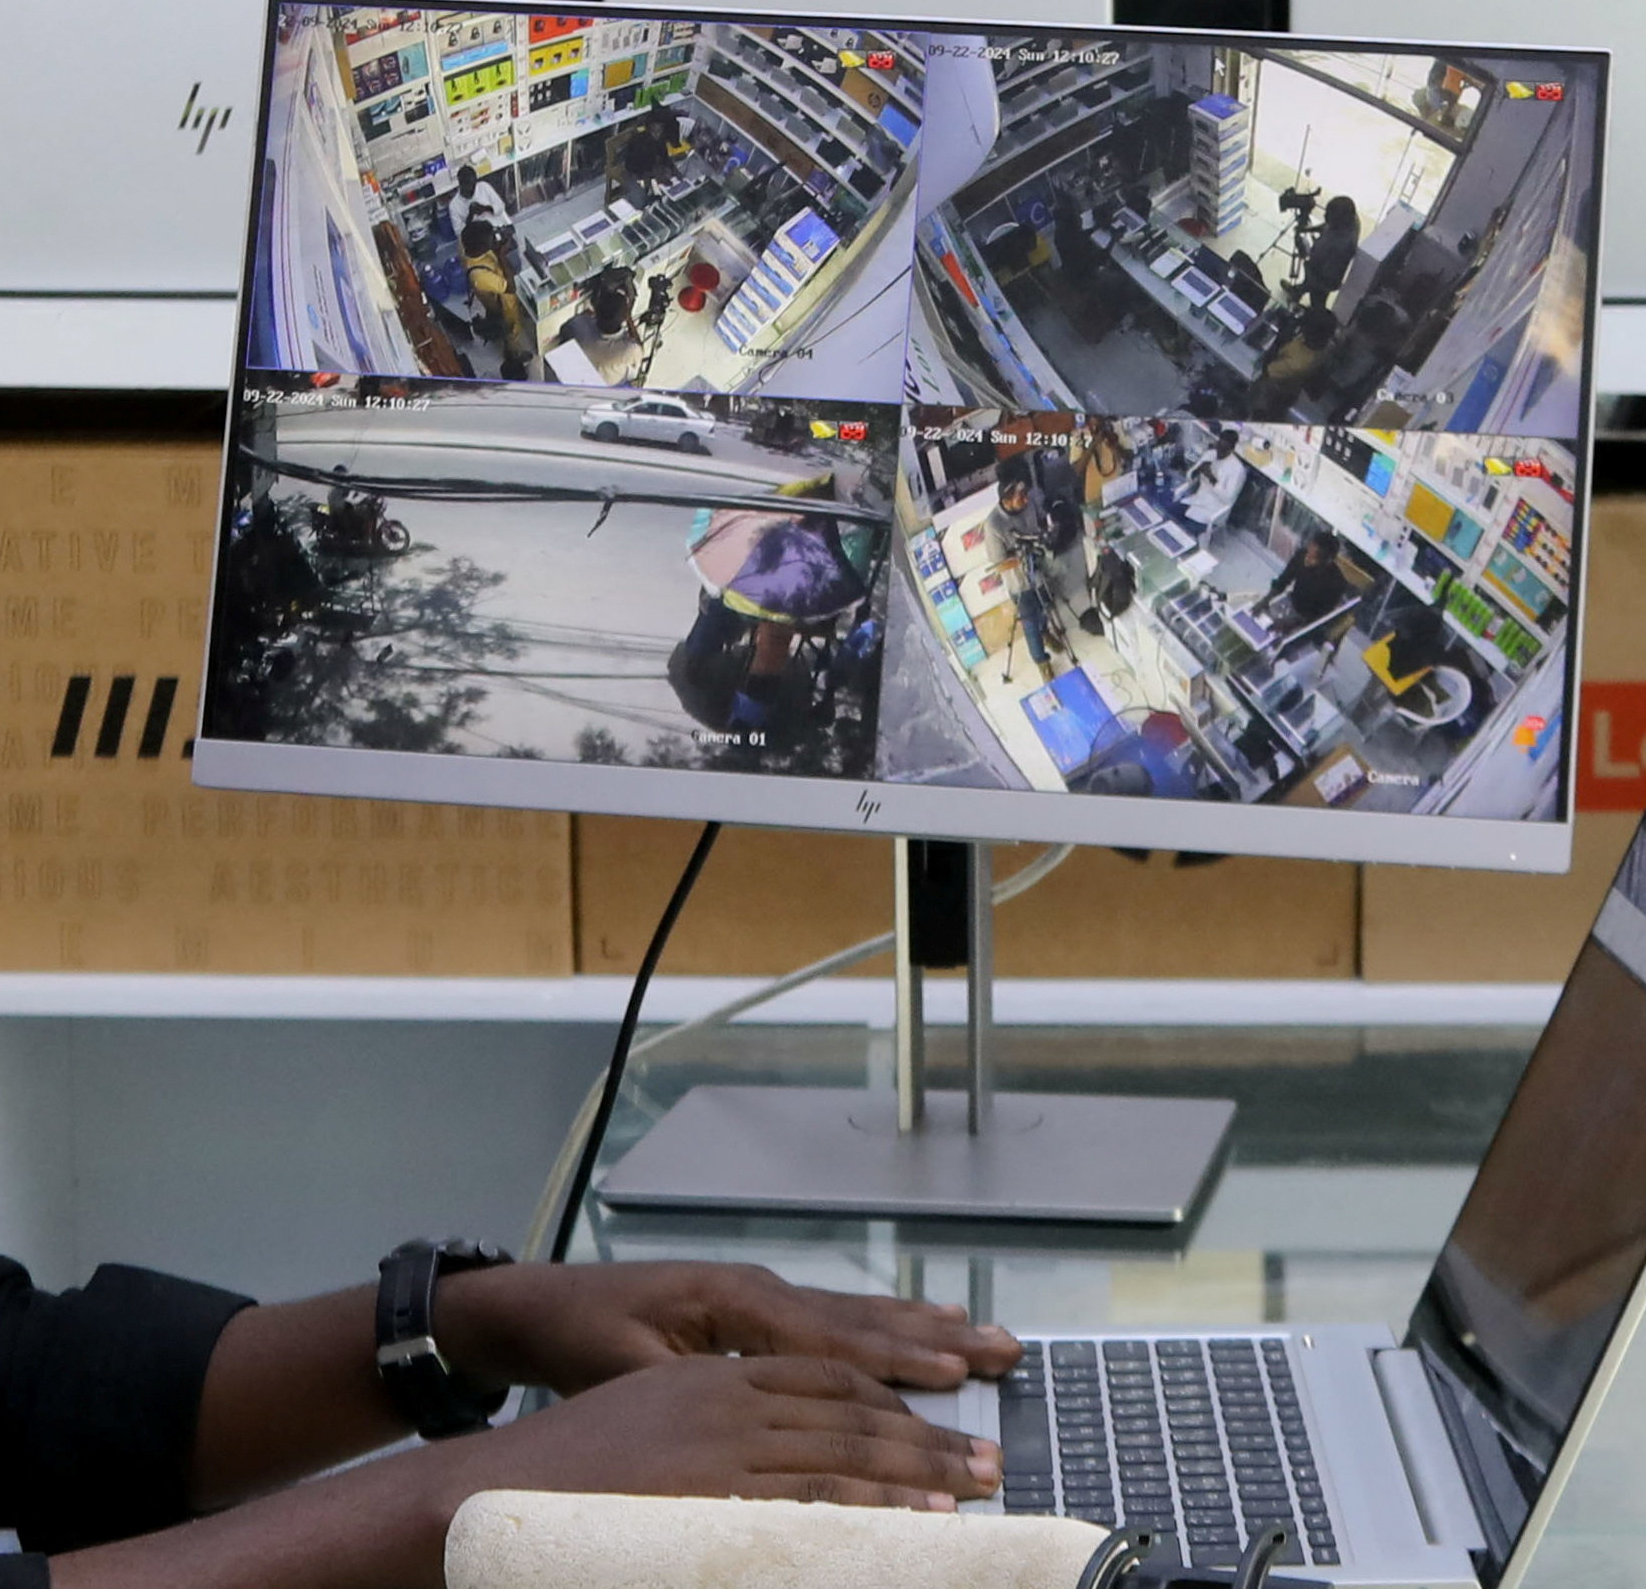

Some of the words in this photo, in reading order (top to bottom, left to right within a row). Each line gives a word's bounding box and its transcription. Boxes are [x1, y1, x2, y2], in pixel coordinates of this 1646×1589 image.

[928, 45, 1011, 60] 09-22-2024
[1018, 49, 1045, 61] Sun
[1054, 50, 1120, 65] 12:10:27
[243, 389, 324, 406] 09-22-2024
[331, 394, 357, 408] Sun
[365, 396, 431, 411] 12:10:27
[991, 430, 1017, 444] Sun
[691, 731, 741, 746] Camera
[749, 732, 767, 746] 01
[1367, 770, 1420, 787] Camera
